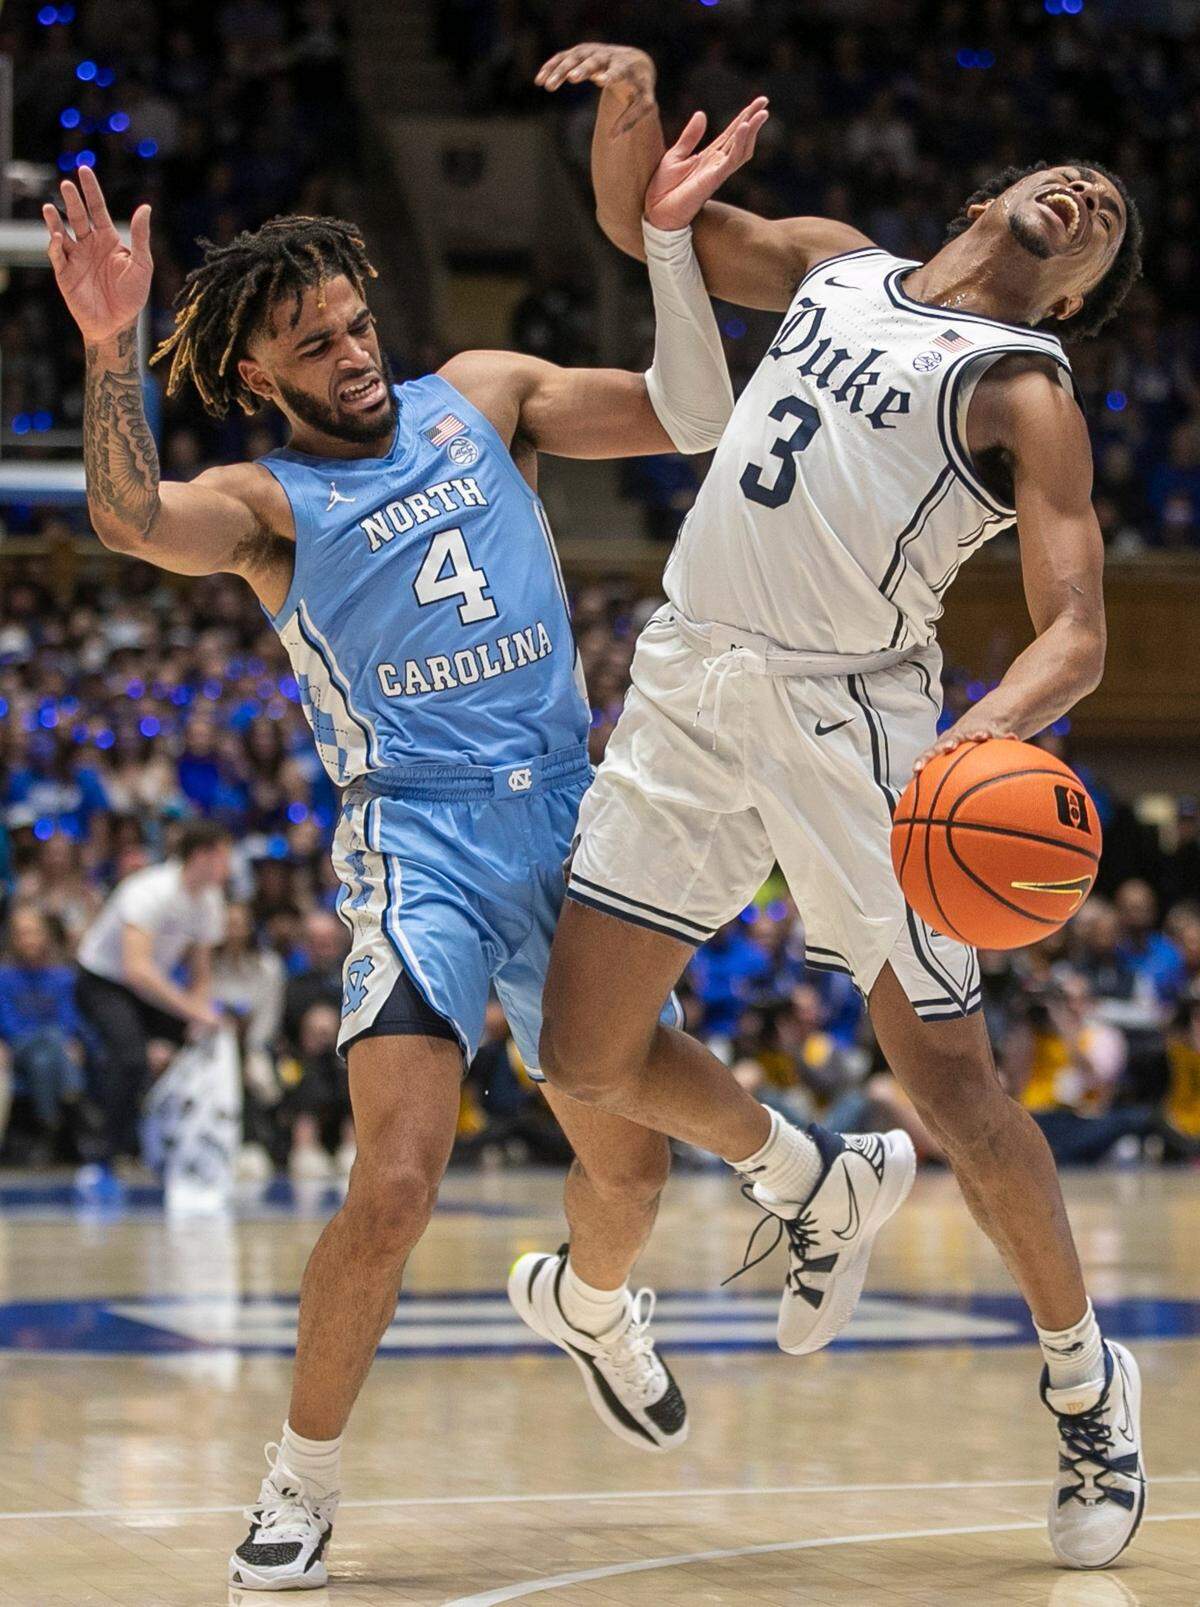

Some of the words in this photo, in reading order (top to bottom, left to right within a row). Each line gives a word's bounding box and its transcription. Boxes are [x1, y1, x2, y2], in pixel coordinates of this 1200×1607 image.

[767, 297, 911, 430] Duke
[739, 395, 822, 509] 3
[360, 477, 488, 553] NORTH
[412, 527, 499, 626] 4
[377, 621, 553, 698] CAROLINA
